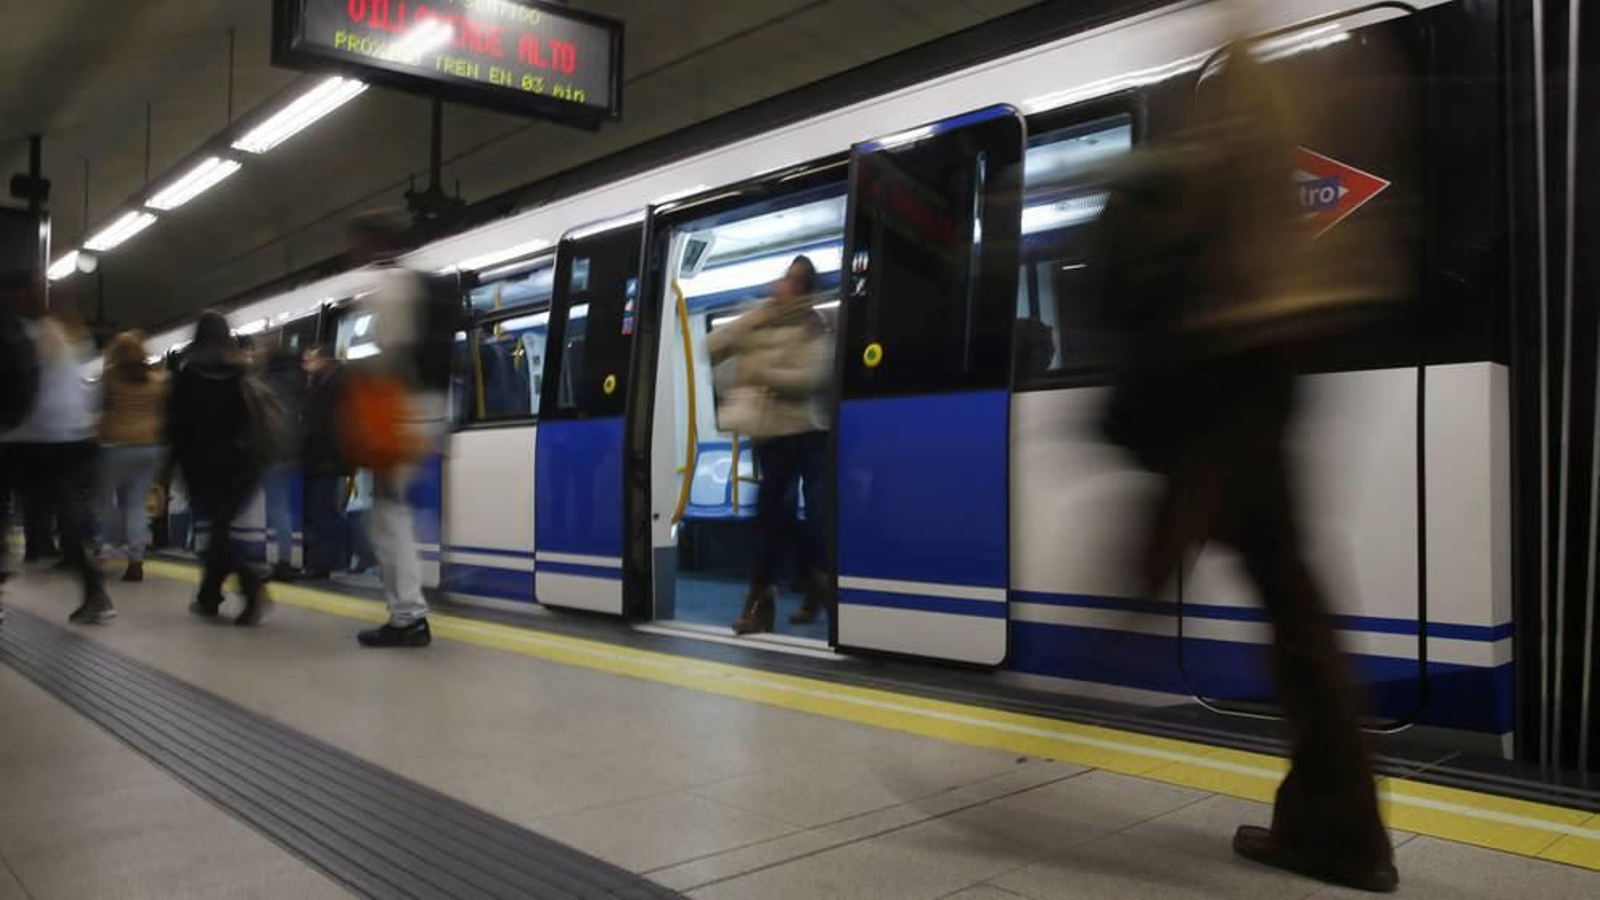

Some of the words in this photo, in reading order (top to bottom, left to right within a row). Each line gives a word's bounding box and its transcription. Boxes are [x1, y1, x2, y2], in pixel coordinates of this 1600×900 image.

[334, 30, 421, 66] PROO
[436, 55, 479, 79] TREN
[489, 66, 513, 87] EN
[553, 82, 586, 103] min
[346, 0, 507, 58] VILLRDE
[517, 35, 576, 75] ALTO
[1299, 184, 1336, 206] tro
